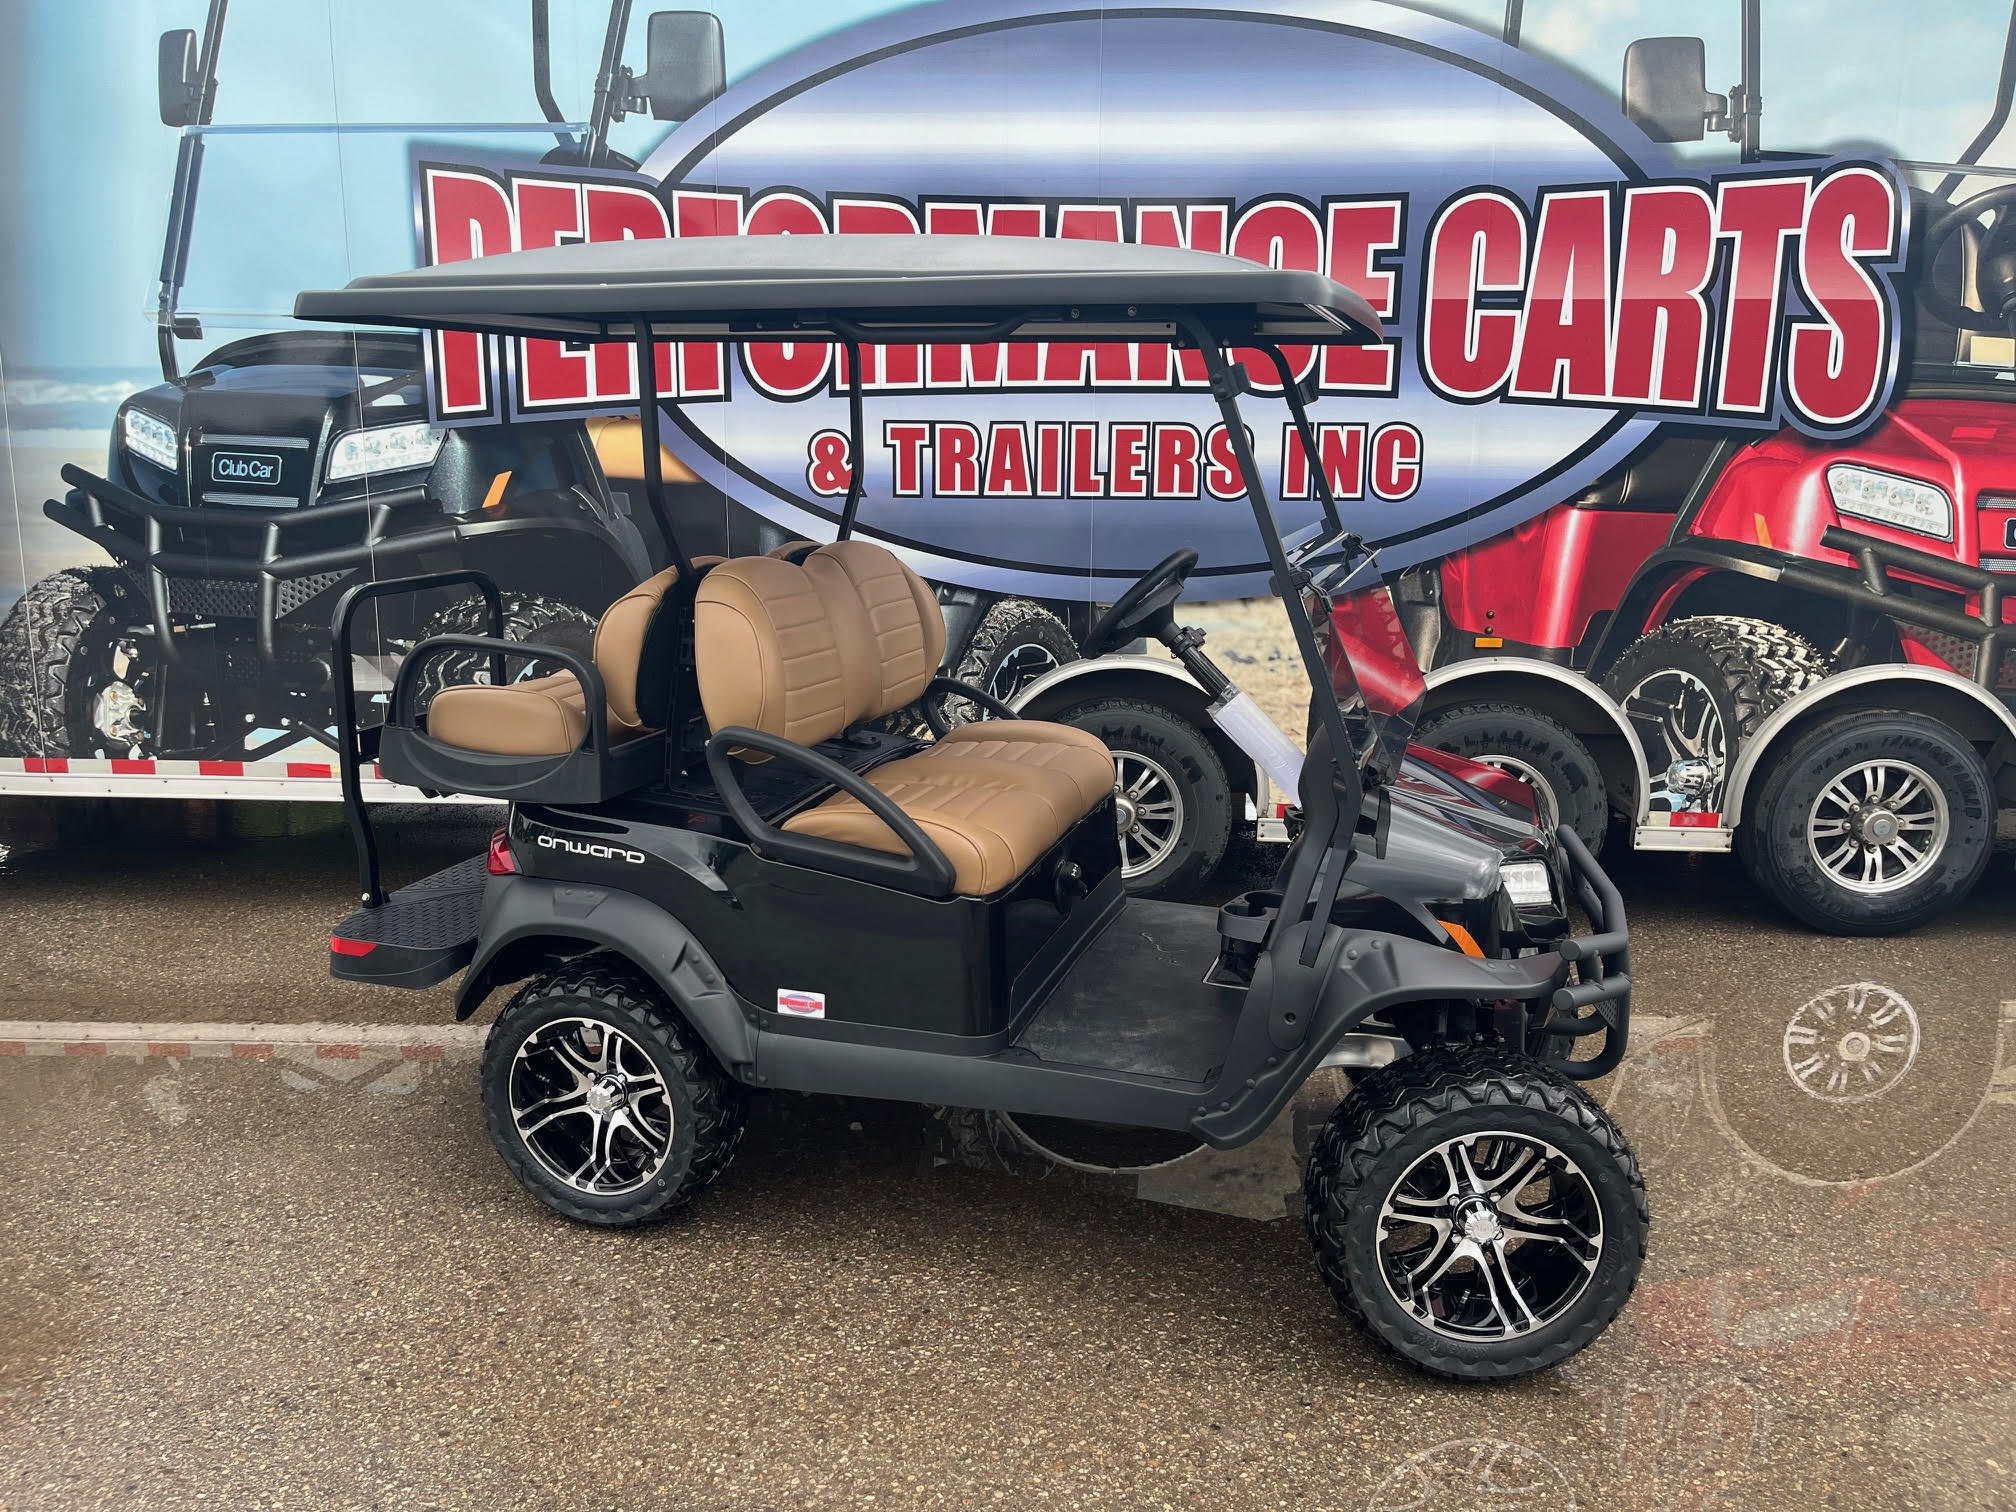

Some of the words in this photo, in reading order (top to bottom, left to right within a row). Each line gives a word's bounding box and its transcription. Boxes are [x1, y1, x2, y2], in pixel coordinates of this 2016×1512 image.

[1418, 162, 1900, 429] CARTS
[218, 458, 249, 477] Club
[249, 460, 274, 478] Car
[807, 429, 866, 498] &
[883, 420, 1255, 502] TRAILERS
[1279, 421, 1423, 502] INC
